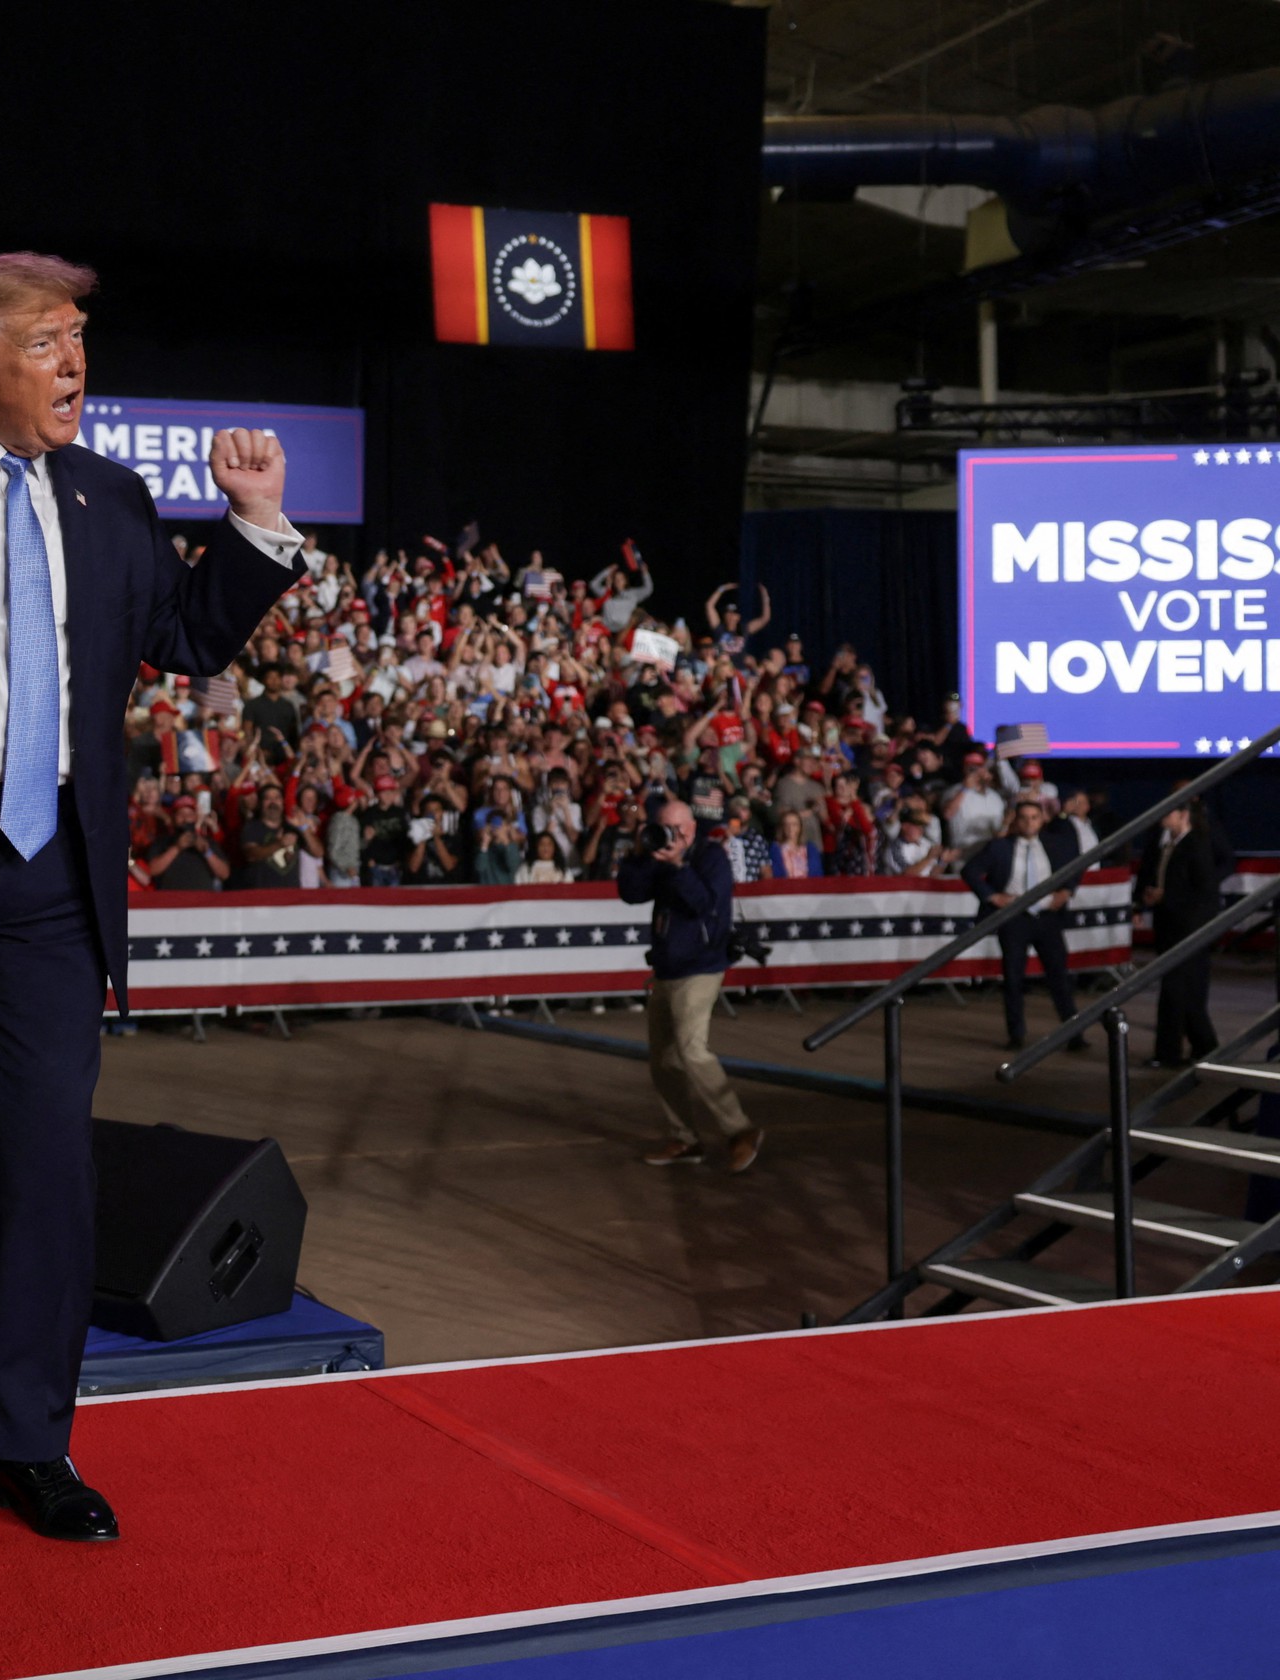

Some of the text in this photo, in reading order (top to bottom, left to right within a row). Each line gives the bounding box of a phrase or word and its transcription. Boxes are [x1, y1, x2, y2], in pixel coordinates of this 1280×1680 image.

[73, 423, 286, 463] MERI
[132, 463, 228, 501] GAI
[992, 518, 1280, 583] MISSIS
[1118, 589, 1268, 632] VOTE
